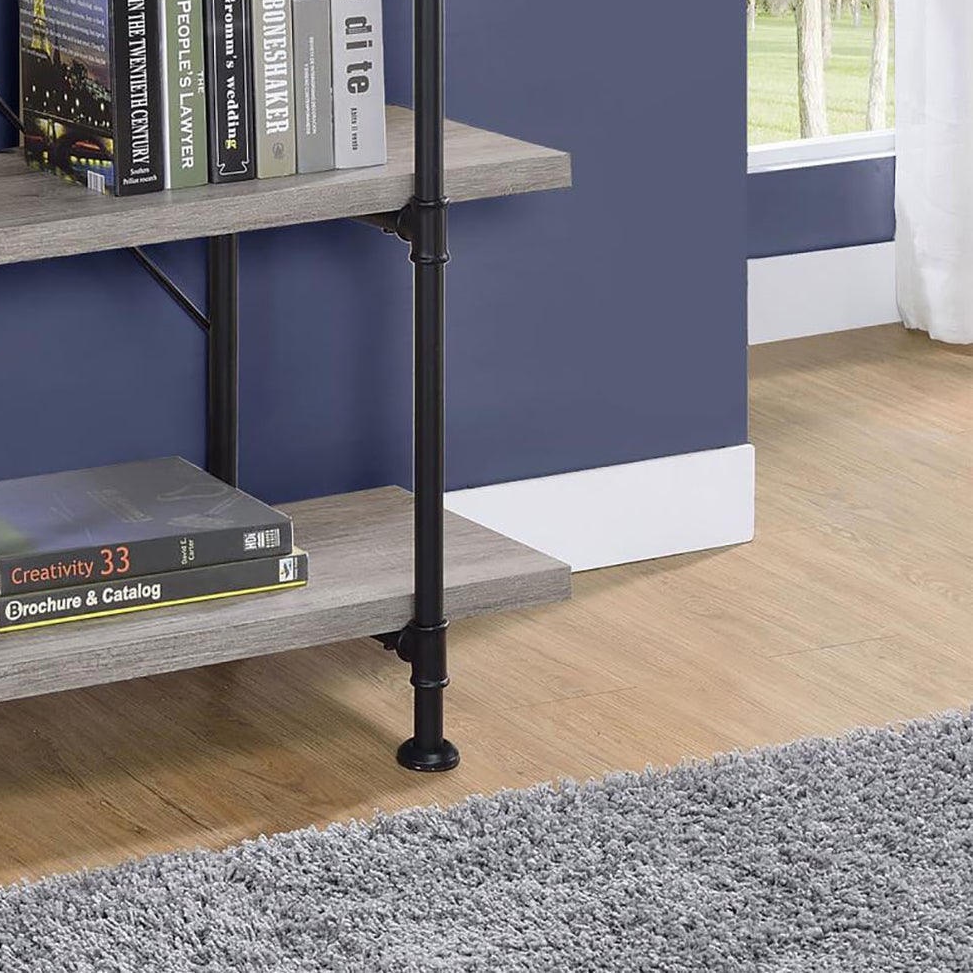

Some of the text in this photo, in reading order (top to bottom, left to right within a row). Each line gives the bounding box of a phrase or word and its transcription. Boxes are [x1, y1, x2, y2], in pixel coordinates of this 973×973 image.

[128, 12, 146, 38] THE
[345, 12, 373, 50] di
[129, 38, 148, 108] TWENTIETH
[177, 0, 194, 169] PEOPLE'S LAWYER
[197, 70, 205, 94] THE
[346, 60, 373, 94] te
[224, 76, 239, 149] wedding
[131, 109, 150, 164] CENTURY
[11, 546, 131, 585] Creativity 33
[5, 583, 162, 621] Brochure & Catalog
